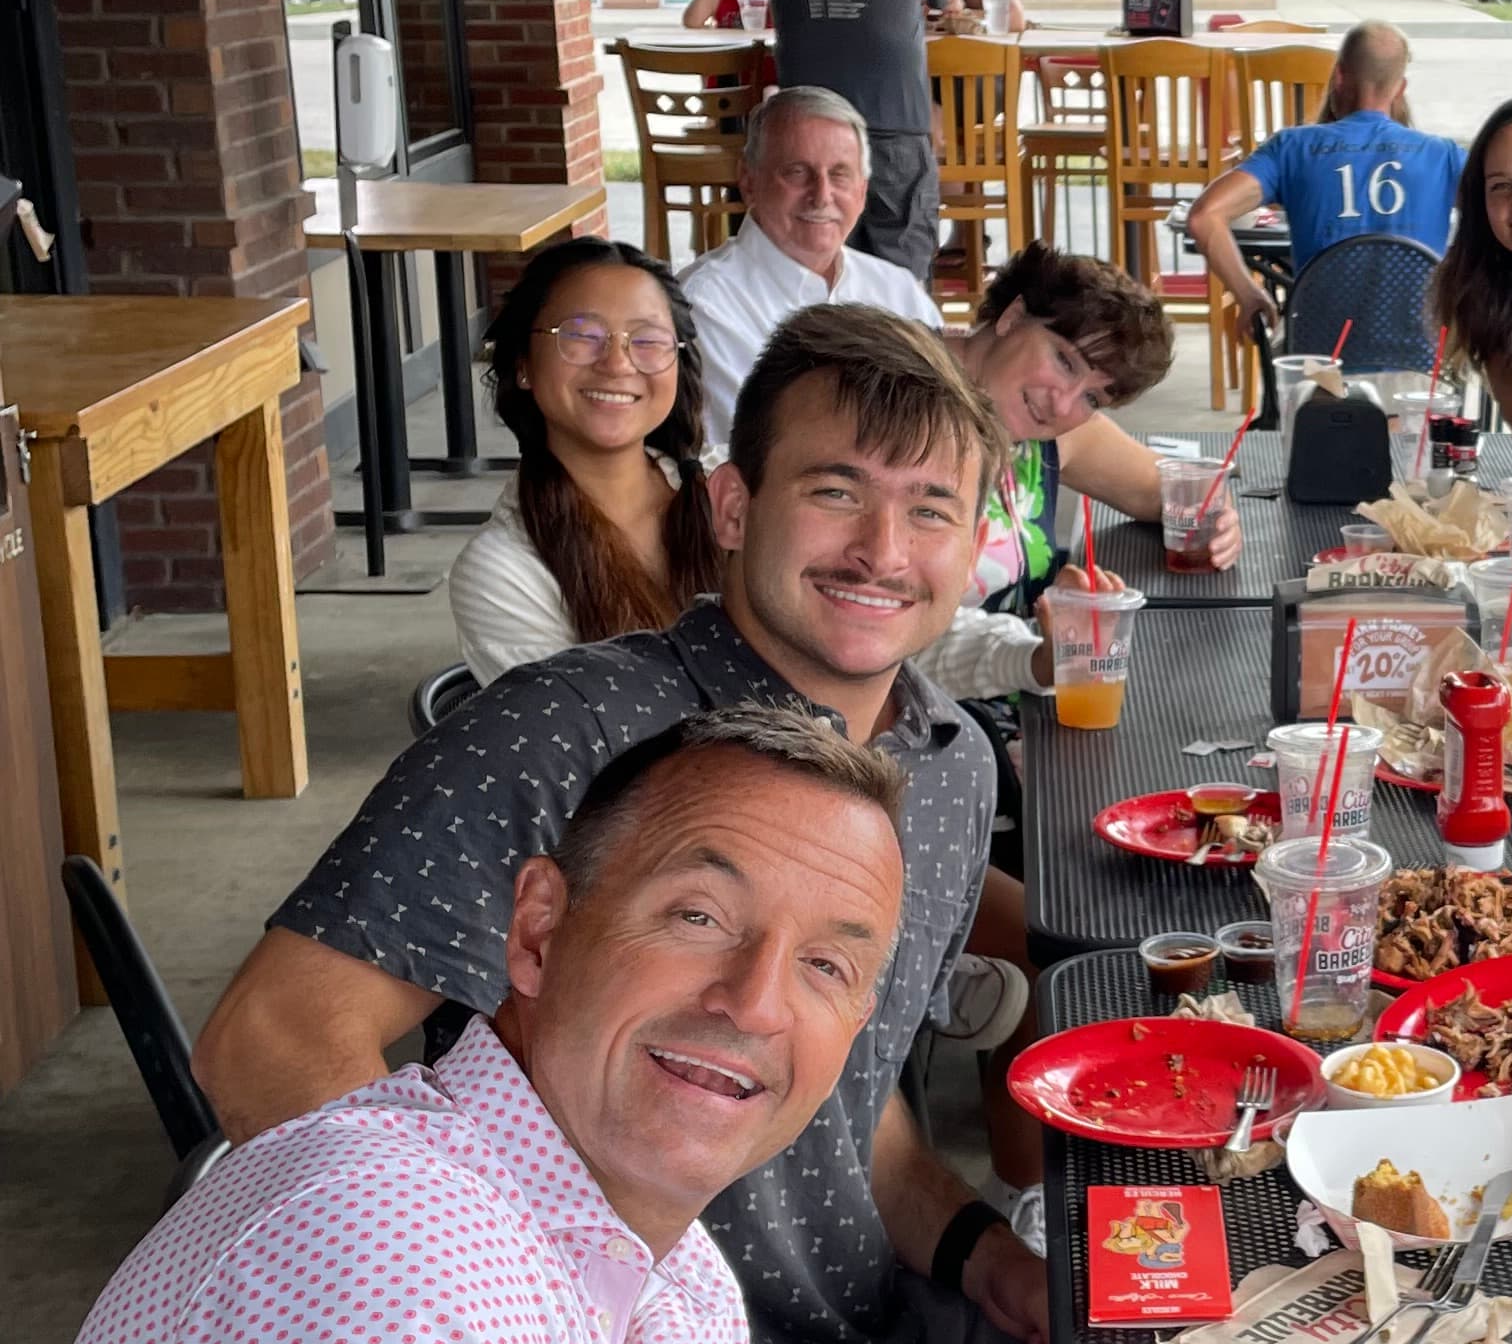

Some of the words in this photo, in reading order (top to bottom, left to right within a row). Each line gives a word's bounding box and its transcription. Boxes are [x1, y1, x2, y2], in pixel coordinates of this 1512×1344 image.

[1334, 161, 1405, 218] 16
[1357, 651, 1408, 684] 20%
[1139, 1279, 1179, 1290] MILK
[1290, 1296, 1371, 1343] ity
